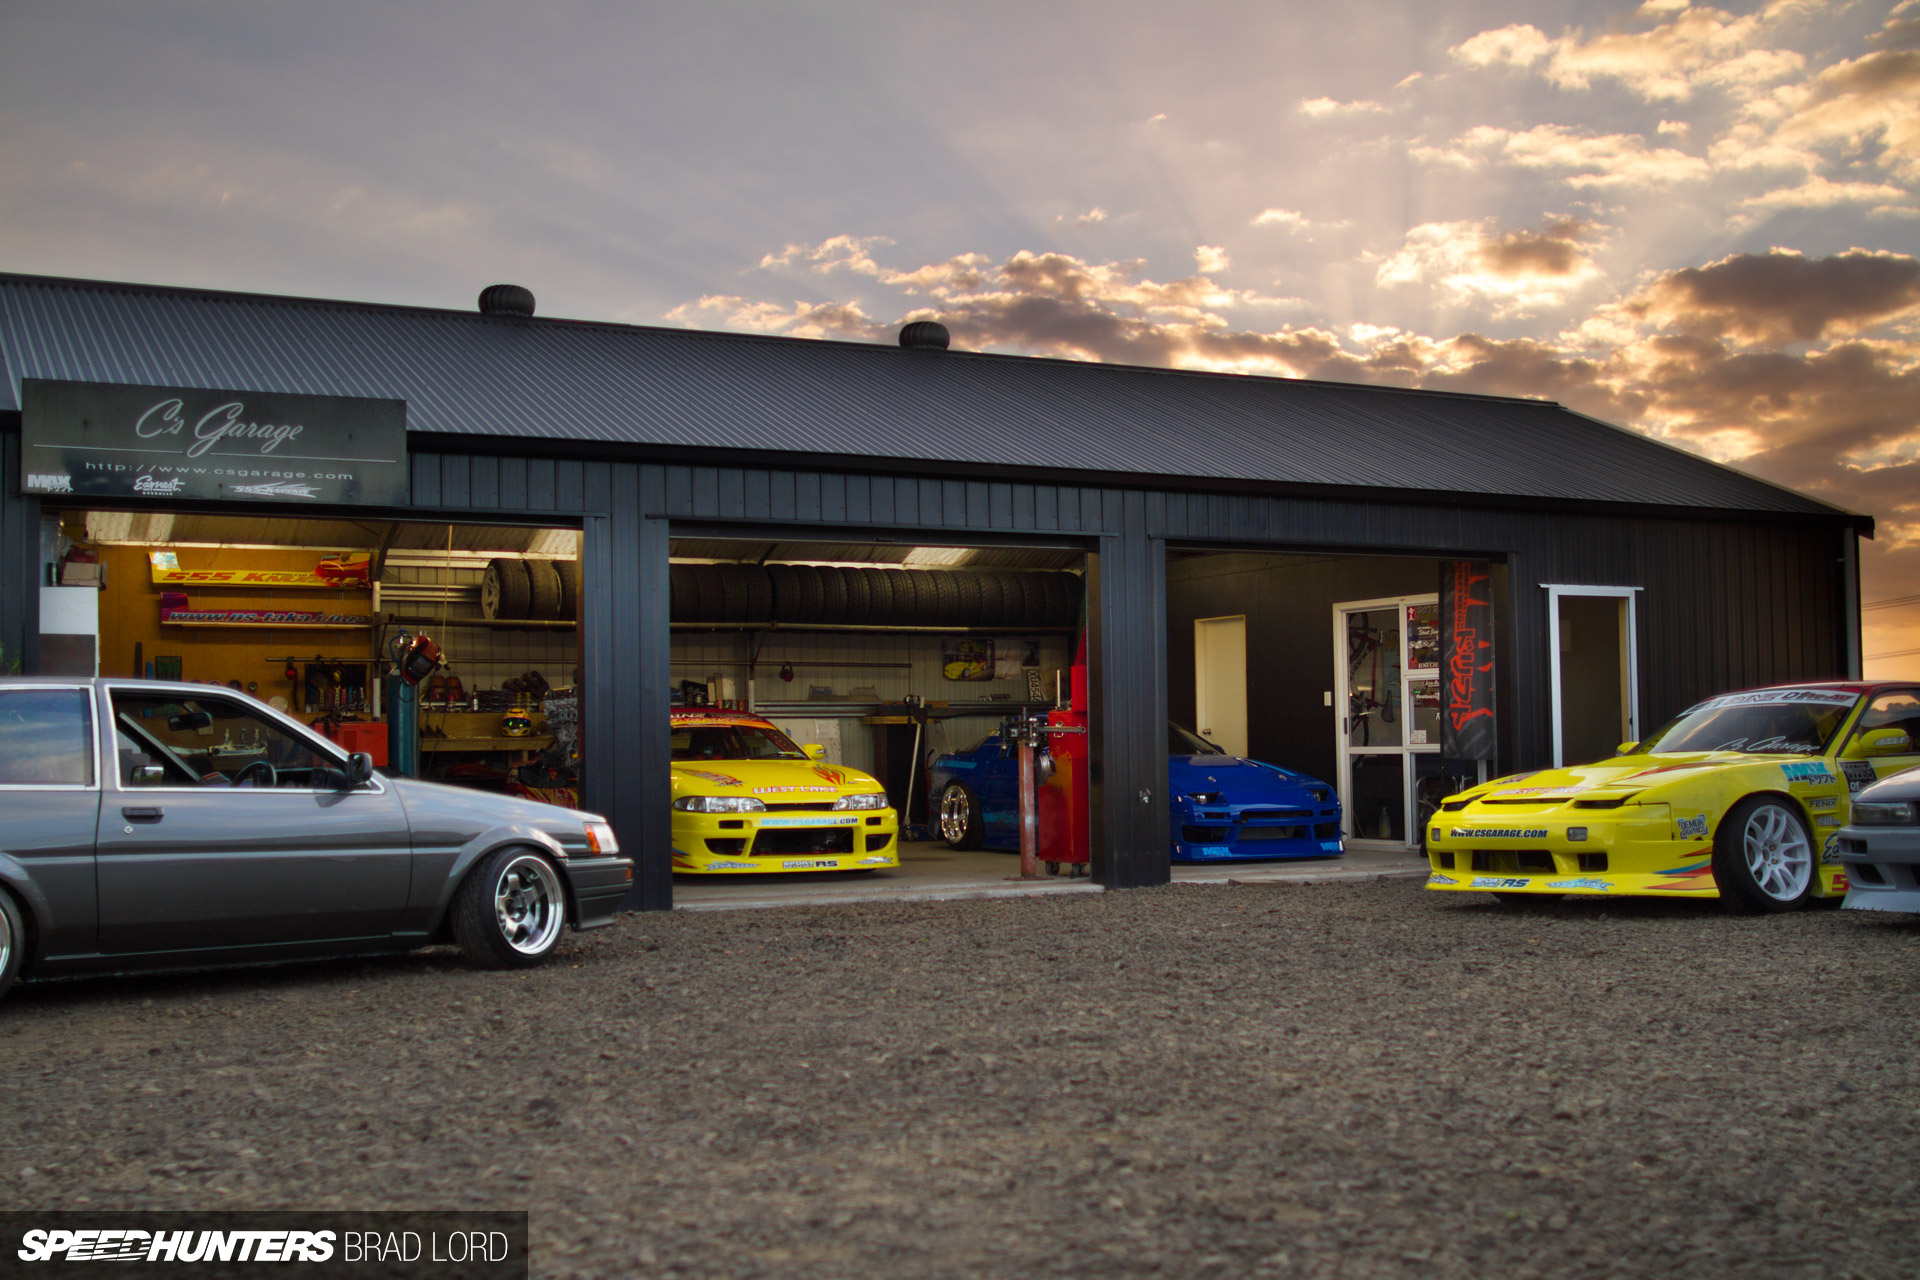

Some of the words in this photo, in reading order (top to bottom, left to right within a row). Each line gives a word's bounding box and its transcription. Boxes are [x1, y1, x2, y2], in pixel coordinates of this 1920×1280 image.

[187, 402, 303, 458] Garage
[86, 462, 354, 480] http://www.csgarage.com
[27, 474, 71, 488] MAX
[162, 572, 236, 581] 555
[1746, 736, 1820, 752] Garage
[1779, 761, 1830, 782] MAX
[1450, 829, 1548, 838] WWW.CSGARAGE.COM
[1500, 879, 1529, 887] RS
